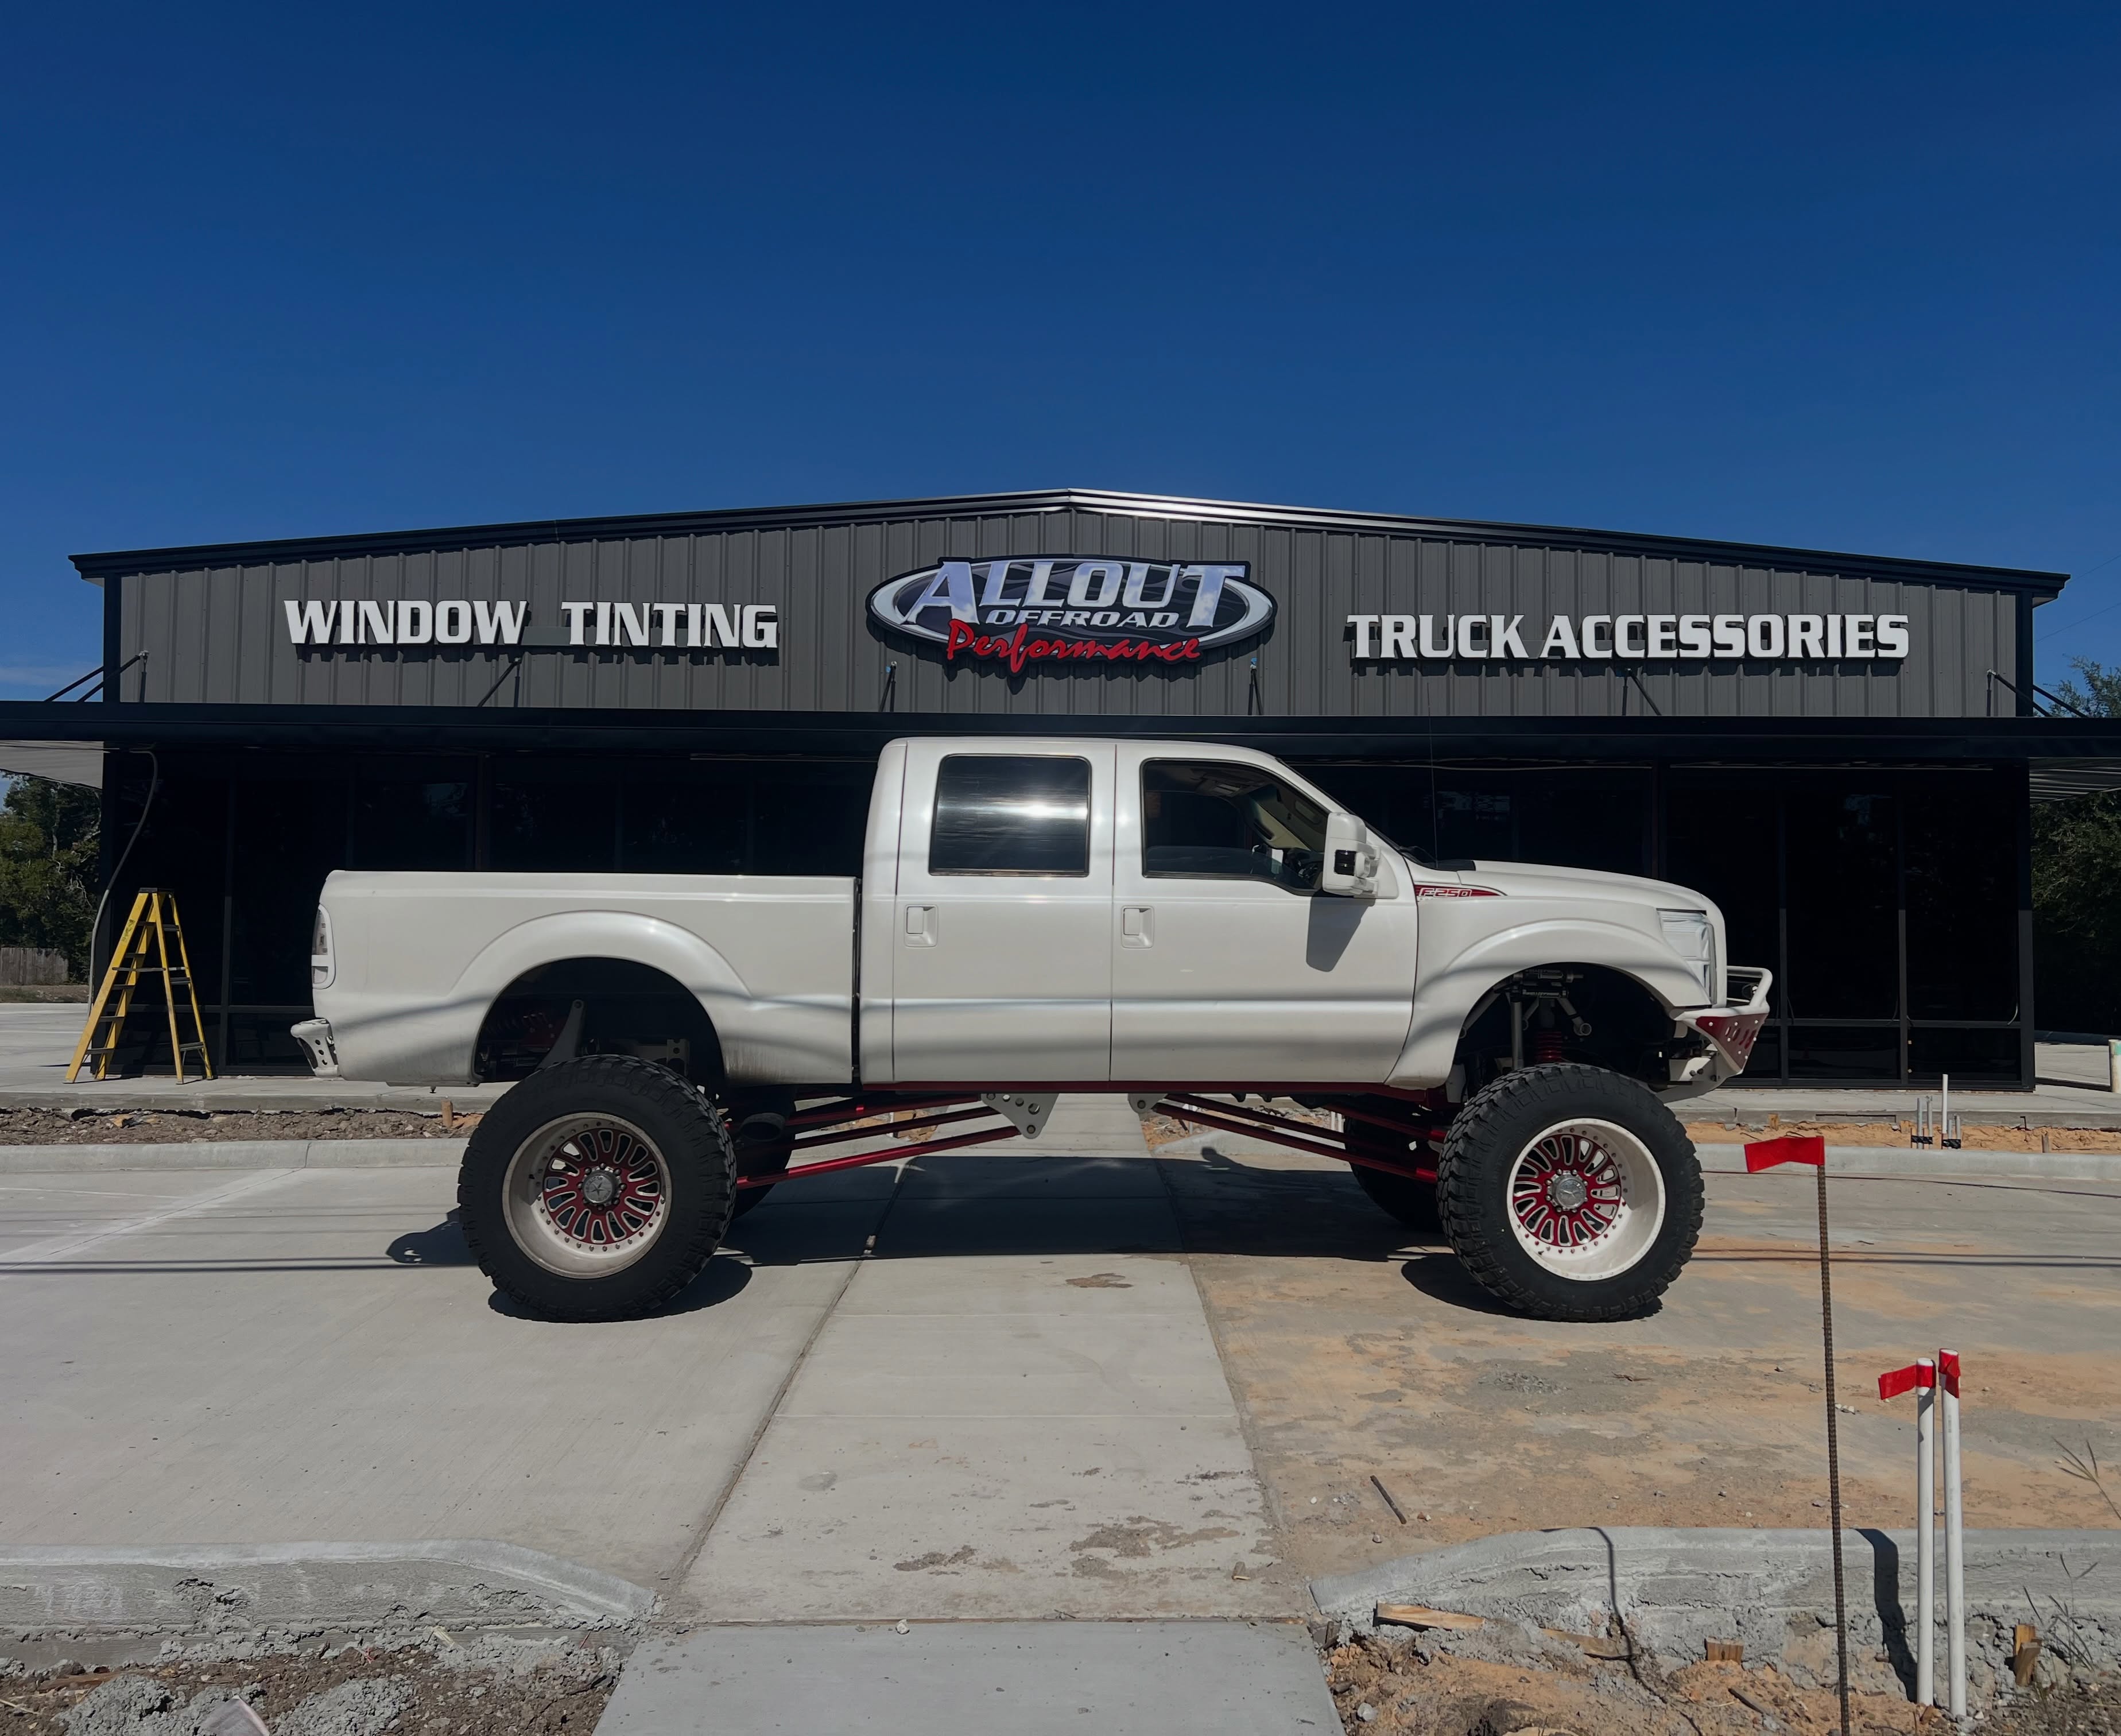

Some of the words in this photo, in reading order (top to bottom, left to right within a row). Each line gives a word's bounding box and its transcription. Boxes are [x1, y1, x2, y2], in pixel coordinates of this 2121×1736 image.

[902, 561, 1246, 628] ALLOUT
[284, 600, 528, 644] WINDOW
[561, 602, 778, 648] TINTING
[985, 609, 1180, 628] OFFROAD
[1347, 614, 1529, 658] TRUCK
[1538, 614, 1909, 658] ACCESSORIES
[946, 618, 1201, 673] Performance
[1419, 888, 1472, 897] F-250
